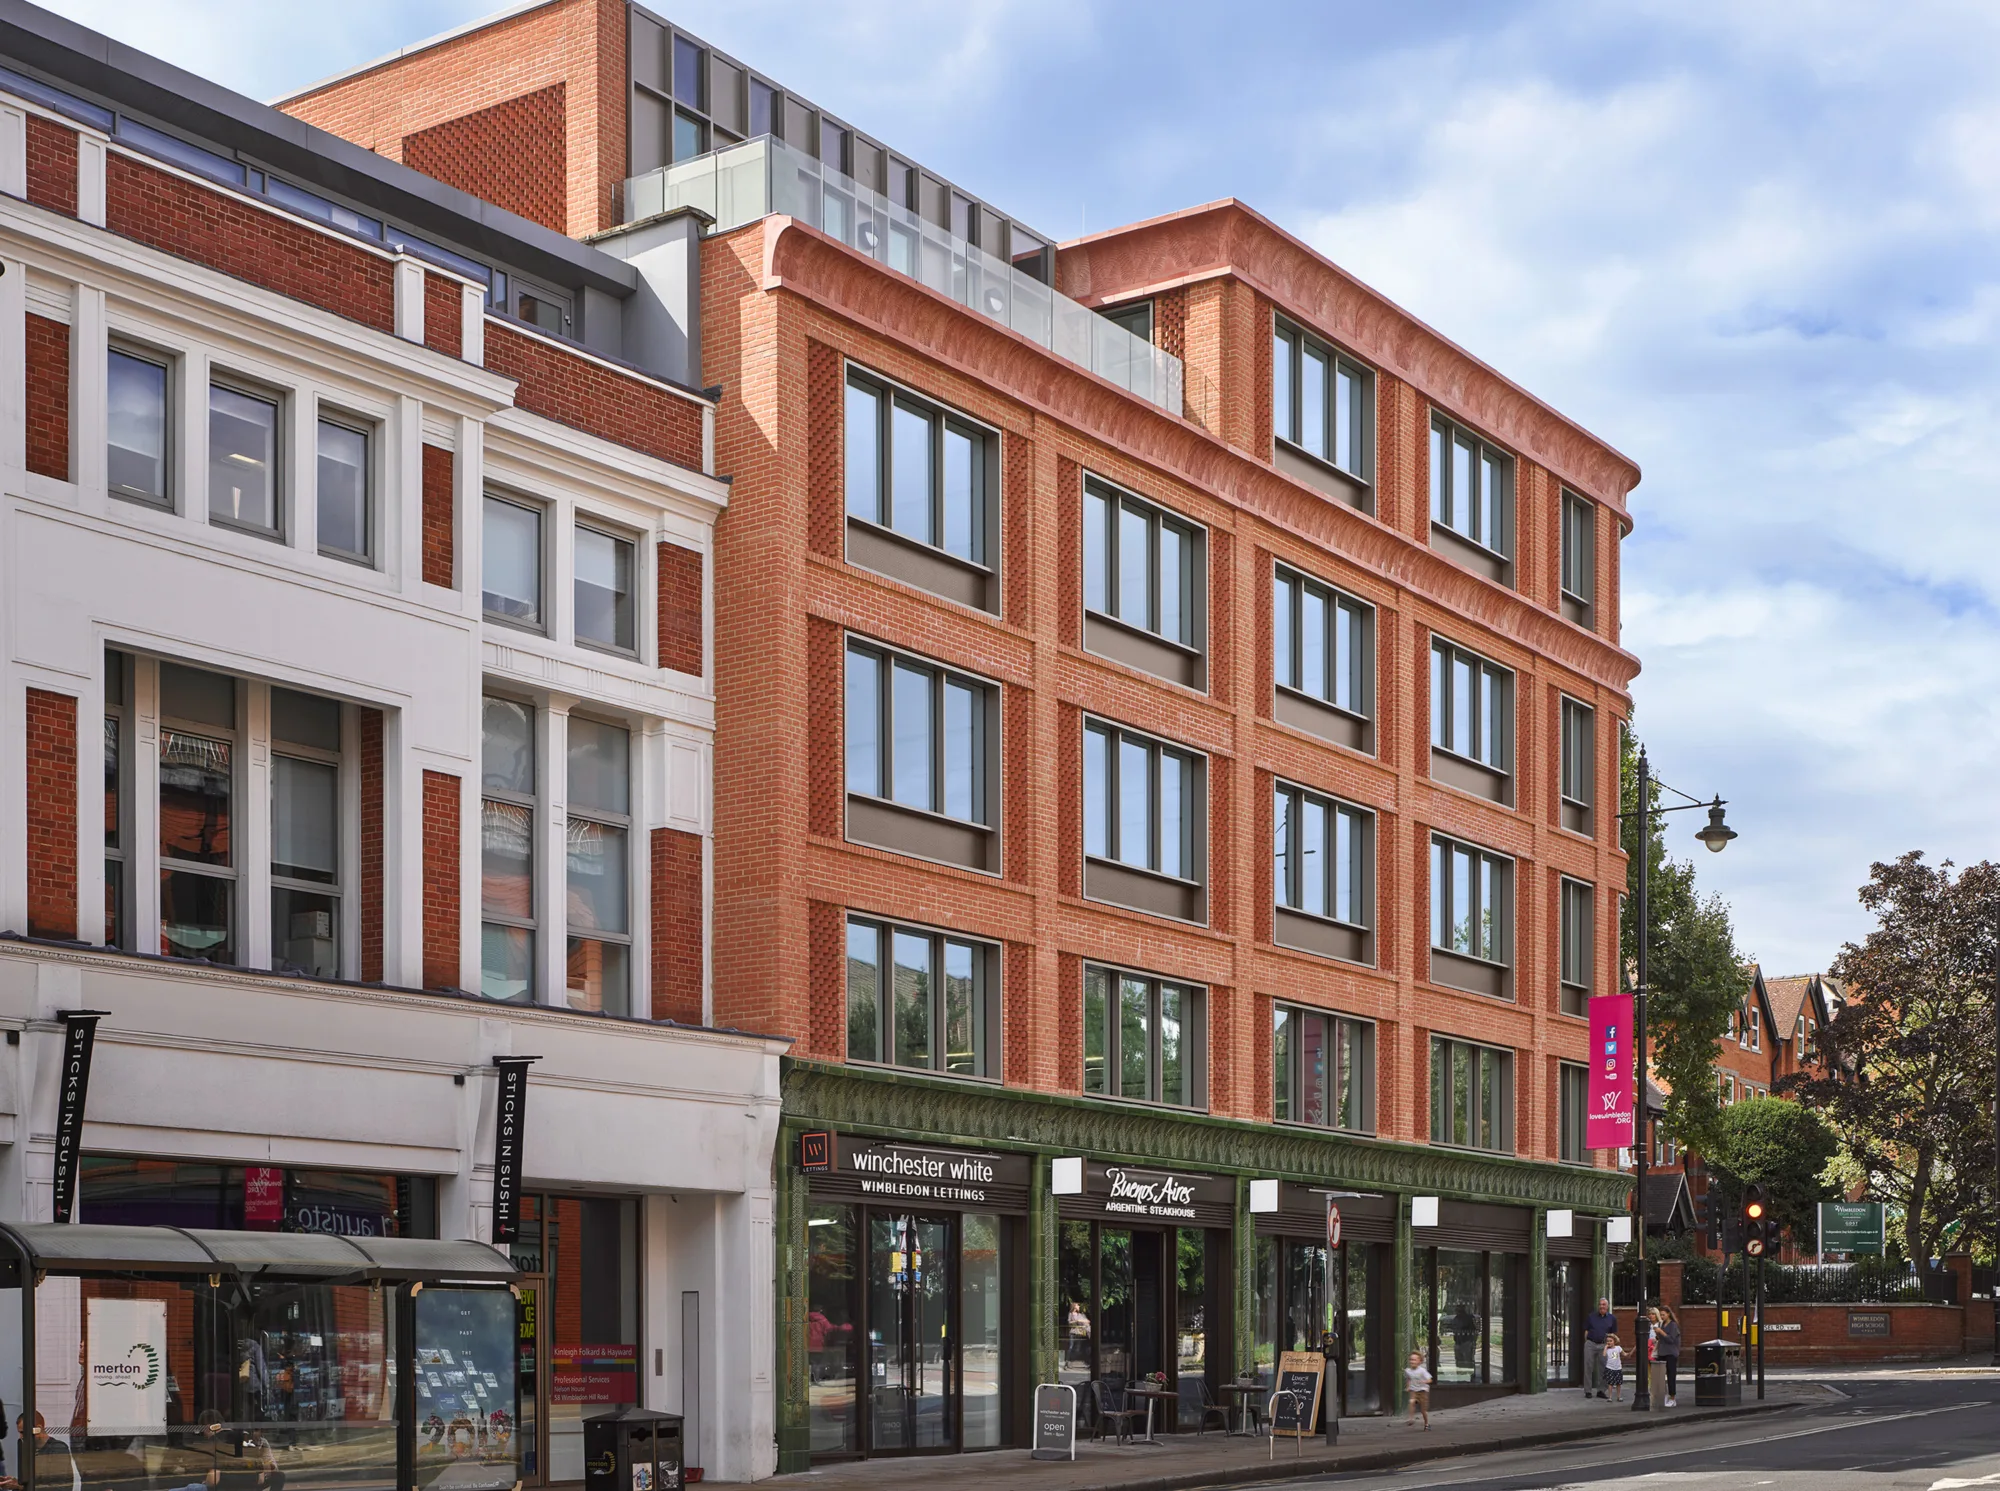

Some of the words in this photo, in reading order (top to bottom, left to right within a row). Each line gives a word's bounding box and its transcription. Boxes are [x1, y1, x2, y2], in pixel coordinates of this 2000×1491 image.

[1589, 1111, 1631, 1120] lovewimbledon
[803, 1165, 828, 1173] LETTINGS
[852, 1149, 946, 1178] winchester
[949, 1158, 993, 1182] white
[861, 1180, 930, 1197] WIMBLEDON
[933, 1186, 985, 1201] LETTINGS
[1105, 1168, 1159, 1204] Buenos
[1153, 1176, 1195, 1204] Aires
[1105, 1202, 1147, 1214] ARGENTINE
[1149, 1206, 1196, 1218] STEAKHOUSE
[554, 1348, 578, 1357] Kinleigh
[579, 1348, 600, 1356] Folkard
[601, 1348, 606, 1356] &
[608, 1348, 633, 1357] Hayward
[94, 1364, 141, 1373] merton
[1044, 1423, 1065, 1431] open
